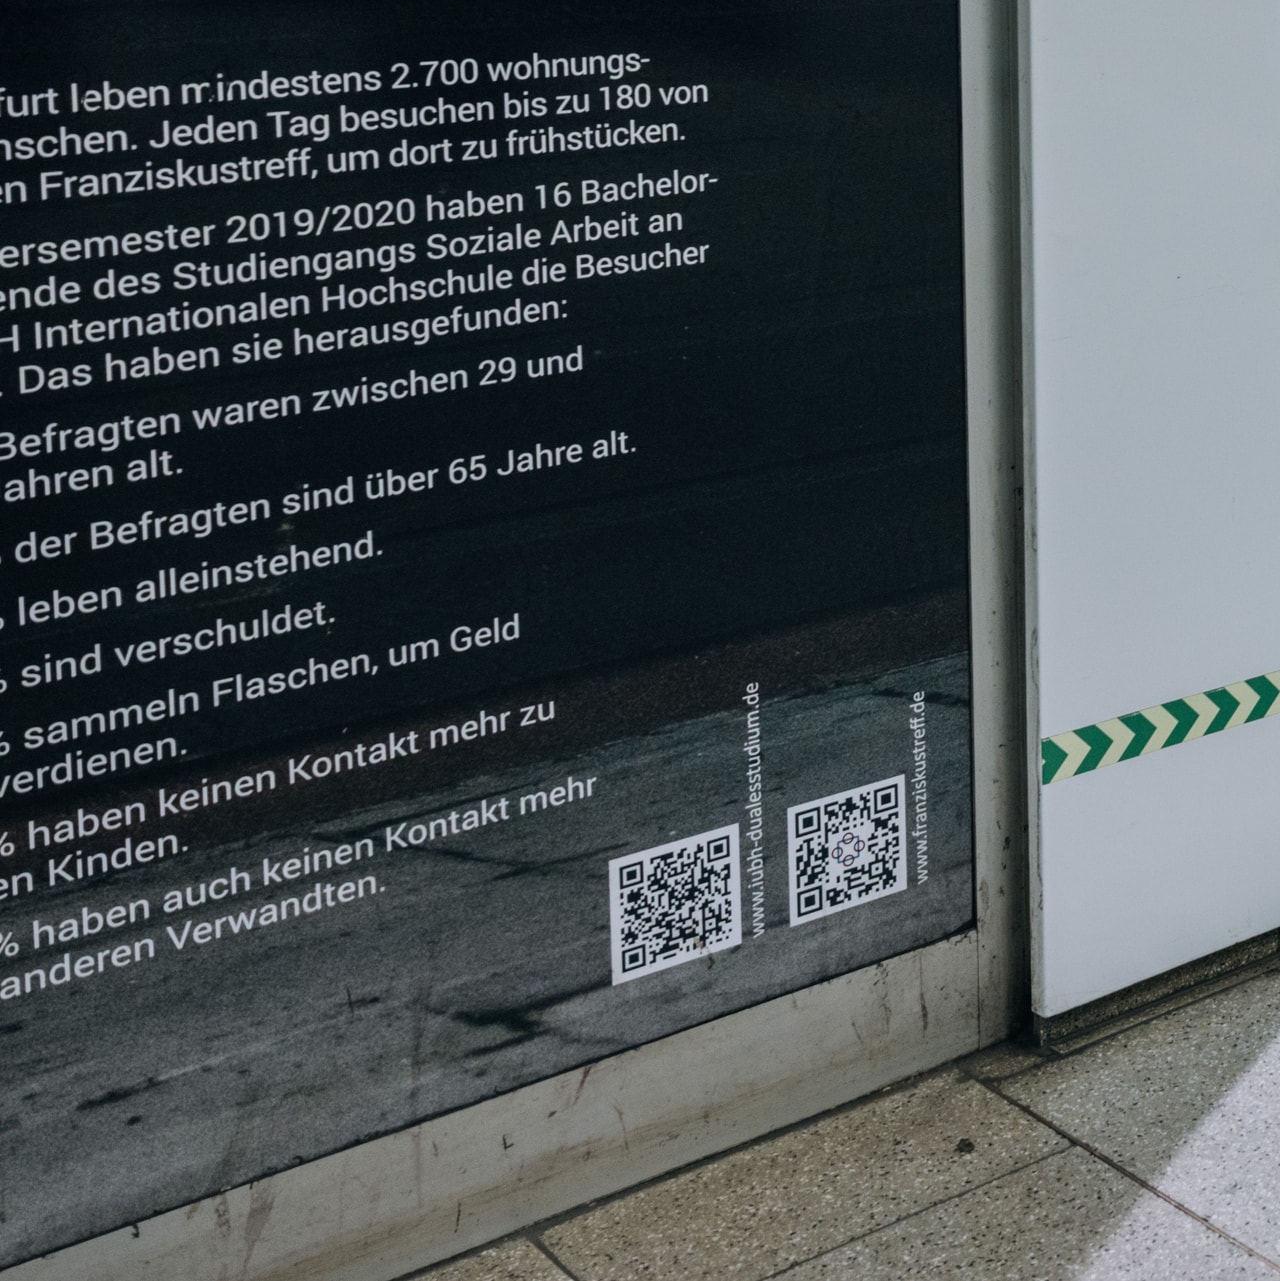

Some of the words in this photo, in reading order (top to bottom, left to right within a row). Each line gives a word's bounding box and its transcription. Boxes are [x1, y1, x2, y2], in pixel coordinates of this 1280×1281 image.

[71, 81, 170, 113] leben
[181, 70, 382, 104] mindestens
[391, 58, 478, 89] 2.700
[487, 53, 650, 81] wohnungs-
[149, 115, 258, 148] Jeden
[266, 111, 330, 142] Tag
[340, 97, 494, 132] besuchen
[504, 91, 547, 119] bis
[556, 94, 590, 114] zu
[599, 83, 651, 110] 180
[658, 84, 708, 105] von
[40, 147, 318, 200] Franziskustreff,
[328, 150, 379, 173] um
[389, 139, 453, 167] dort
[462, 139, 497, 161] zu
[506, 119, 685, 156] frühstücken.
[0, 225, 216, 268] ersemester
[226, 198, 415, 243] 2019/2020
[426, 190, 523, 221] haben
[535, 182, 571, 209] 16
[582, 169, 718, 204] Bachelor-
[93, 269, 161, 299] des
[173, 243, 416, 290] Studiengangs
[427, 223, 541, 259] Soziale
[550, 211, 639, 245] Arbeit
[649, 212, 682, 233] an
[35, 292, 310, 349] Internationalen
[322, 264, 513, 312] Hochschule
[522, 258, 566, 286] die
[576, 243, 709, 279] Besucher
[19, 364, 92, 394] Das
[105, 346, 219, 382] haben
[232, 333, 283, 364] sie
[294, 298, 567, 355] herausgefunden:
[192, 395, 301, 429] waren
[312, 370, 468, 412] zwischen
[478, 357, 516, 385] 29
[527, 345, 583, 378] und
[15, 531, 77, 563] der
[91, 499, 270, 550] Befragten
[283, 476, 354, 514] sind
[366, 468, 439, 499] über
[449, 455, 487, 484] 65
[497, 443, 583, 475] Jahre
[592, 430, 636, 459] alt.
[127, 449, 182, 481] alt.
[18, 587, 122, 626] leben
[136, 530, 382, 602] alleinstehend.
[21, 643, 101, 687] sind
[114, 602, 335, 667] verschuldet.
[24, 689, 199, 749] sammeln
[213, 654, 378, 707] Flaschen,
[389, 639, 439, 666] um
[450, 613, 519, 652] Geld
[28, 802, 145, 850] haben
[159, 770, 275, 817] keinen
[289, 731, 420, 784] Kontakt
[430, 710, 511, 749] mehr
[520, 701, 555, 726] zu
[742, 682, 765, 939] www.iubh-dualesstudium.de
[910, 691, 929, 885] www.franziskustreff.de
[33, 899, 149, 949] haben
[163, 867, 250, 913] auch
[263, 839, 374, 886] keinen
[385, 797, 510, 852] Kontakt
[519, 776, 597, 815] mehr
[49, 835, 188, 886] Kinden.
[0, 938, 154, 1000] anderen
[166, 876, 385, 950] Verwandten.
